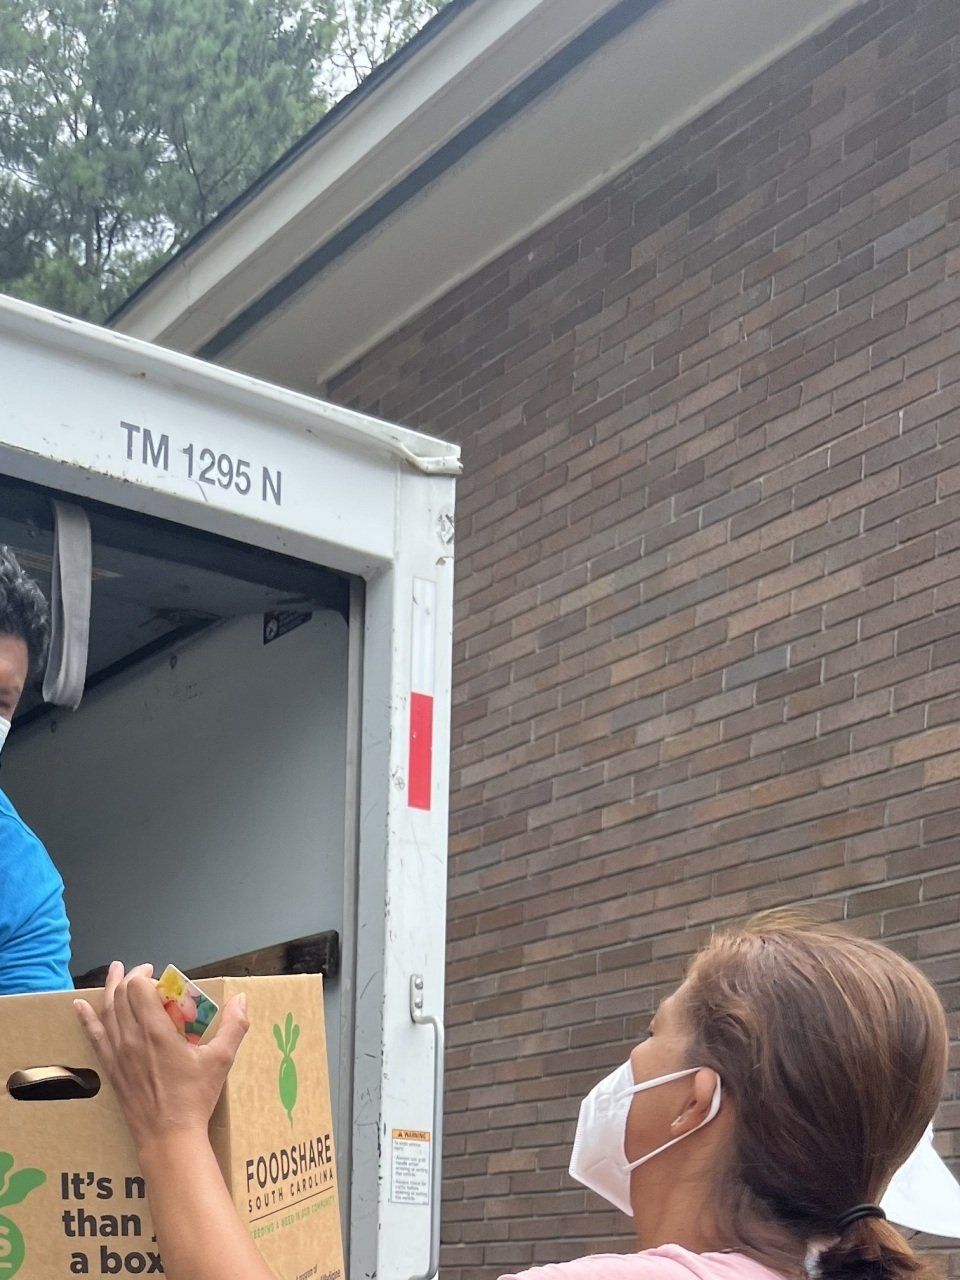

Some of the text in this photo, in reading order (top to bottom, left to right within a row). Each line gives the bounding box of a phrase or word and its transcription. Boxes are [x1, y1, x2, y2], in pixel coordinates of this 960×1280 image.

[120, 420, 282, 506] TM 1295 N
[246, 1134, 332, 1194] FOODSHARE
[248, 1168, 334, 1213] SOUTH CAROLINA
[62, 1208, 142, 1237] than
[70, 1245, 164, 1274] a box
